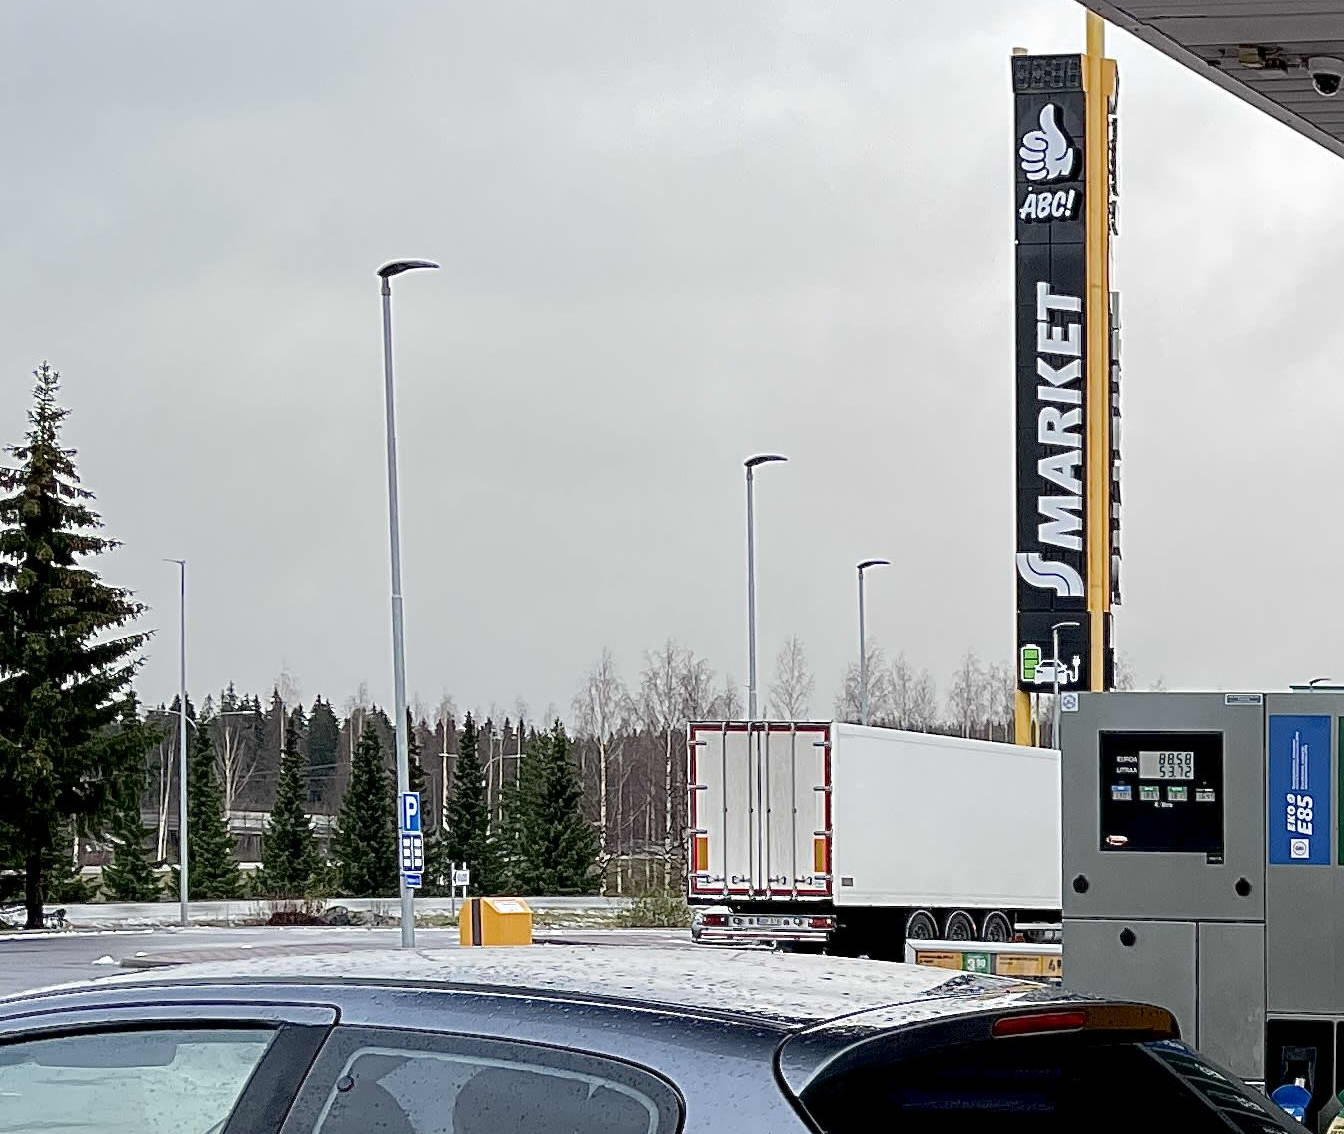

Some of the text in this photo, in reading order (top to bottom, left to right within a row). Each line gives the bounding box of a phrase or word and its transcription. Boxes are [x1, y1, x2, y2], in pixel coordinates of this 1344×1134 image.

[1019, 188, 1076, 220] ABC!
[1037, 281, 1083, 551] MARKET
[1296, 794, 1313, 836] E85
